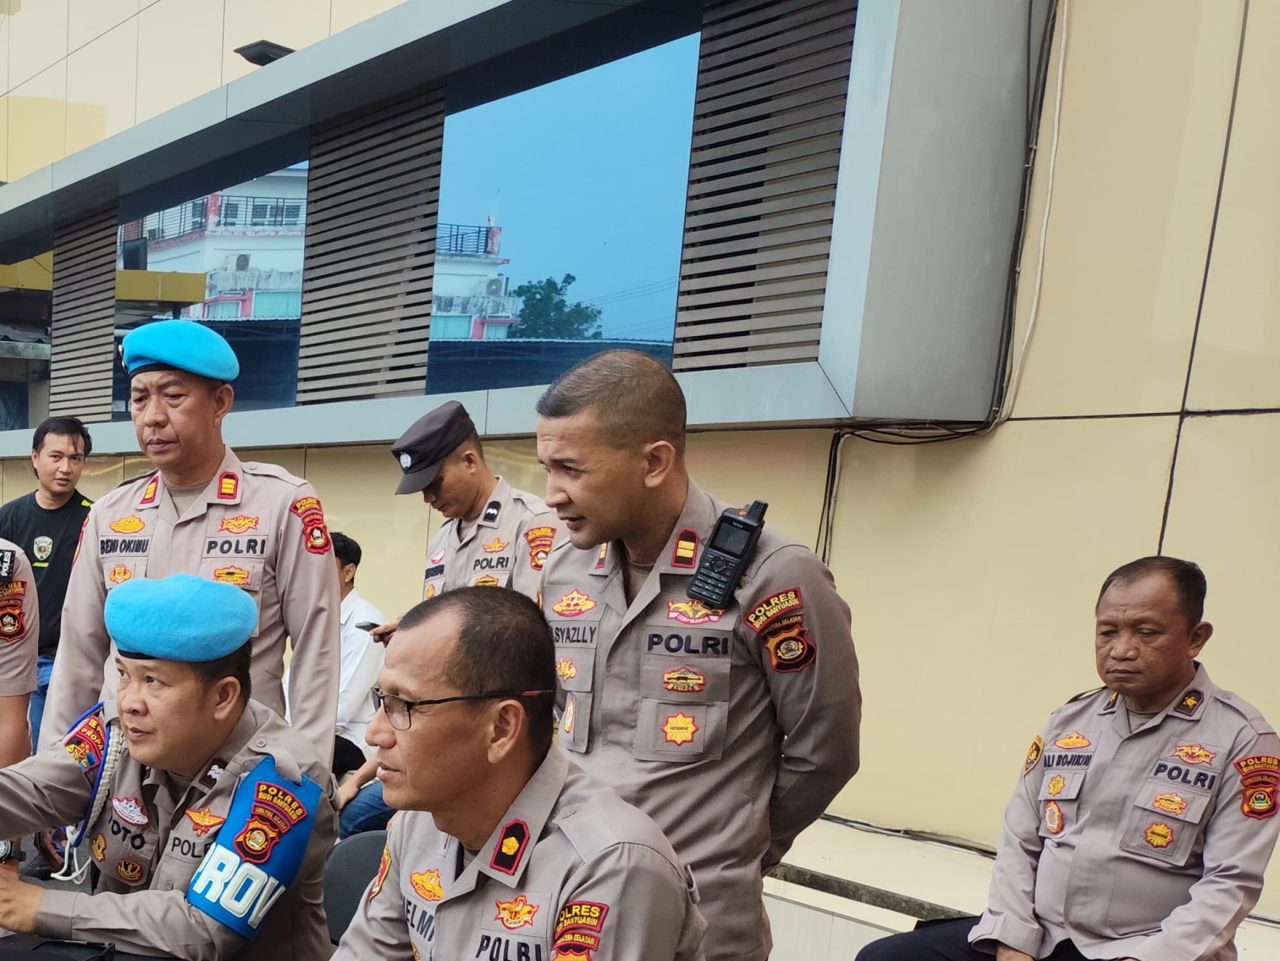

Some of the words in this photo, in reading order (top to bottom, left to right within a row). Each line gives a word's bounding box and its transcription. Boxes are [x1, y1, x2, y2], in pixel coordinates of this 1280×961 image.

[206, 538, 267, 555] POLRI
[473, 556, 510, 571] POLRI
[748, 591, 796, 623] POLRES
[647, 633, 729, 655] POLRI
[81, 727, 104, 751] PROPA
[1153, 763, 1217, 790] POLRI
[259, 784, 304, 816] POLRES
[109, 815, 146, 851] OTO
[171, 836, 212, 859] POL
[191, 841, 287, 930] ROV
[559, 904, 601, 922] OLRES
